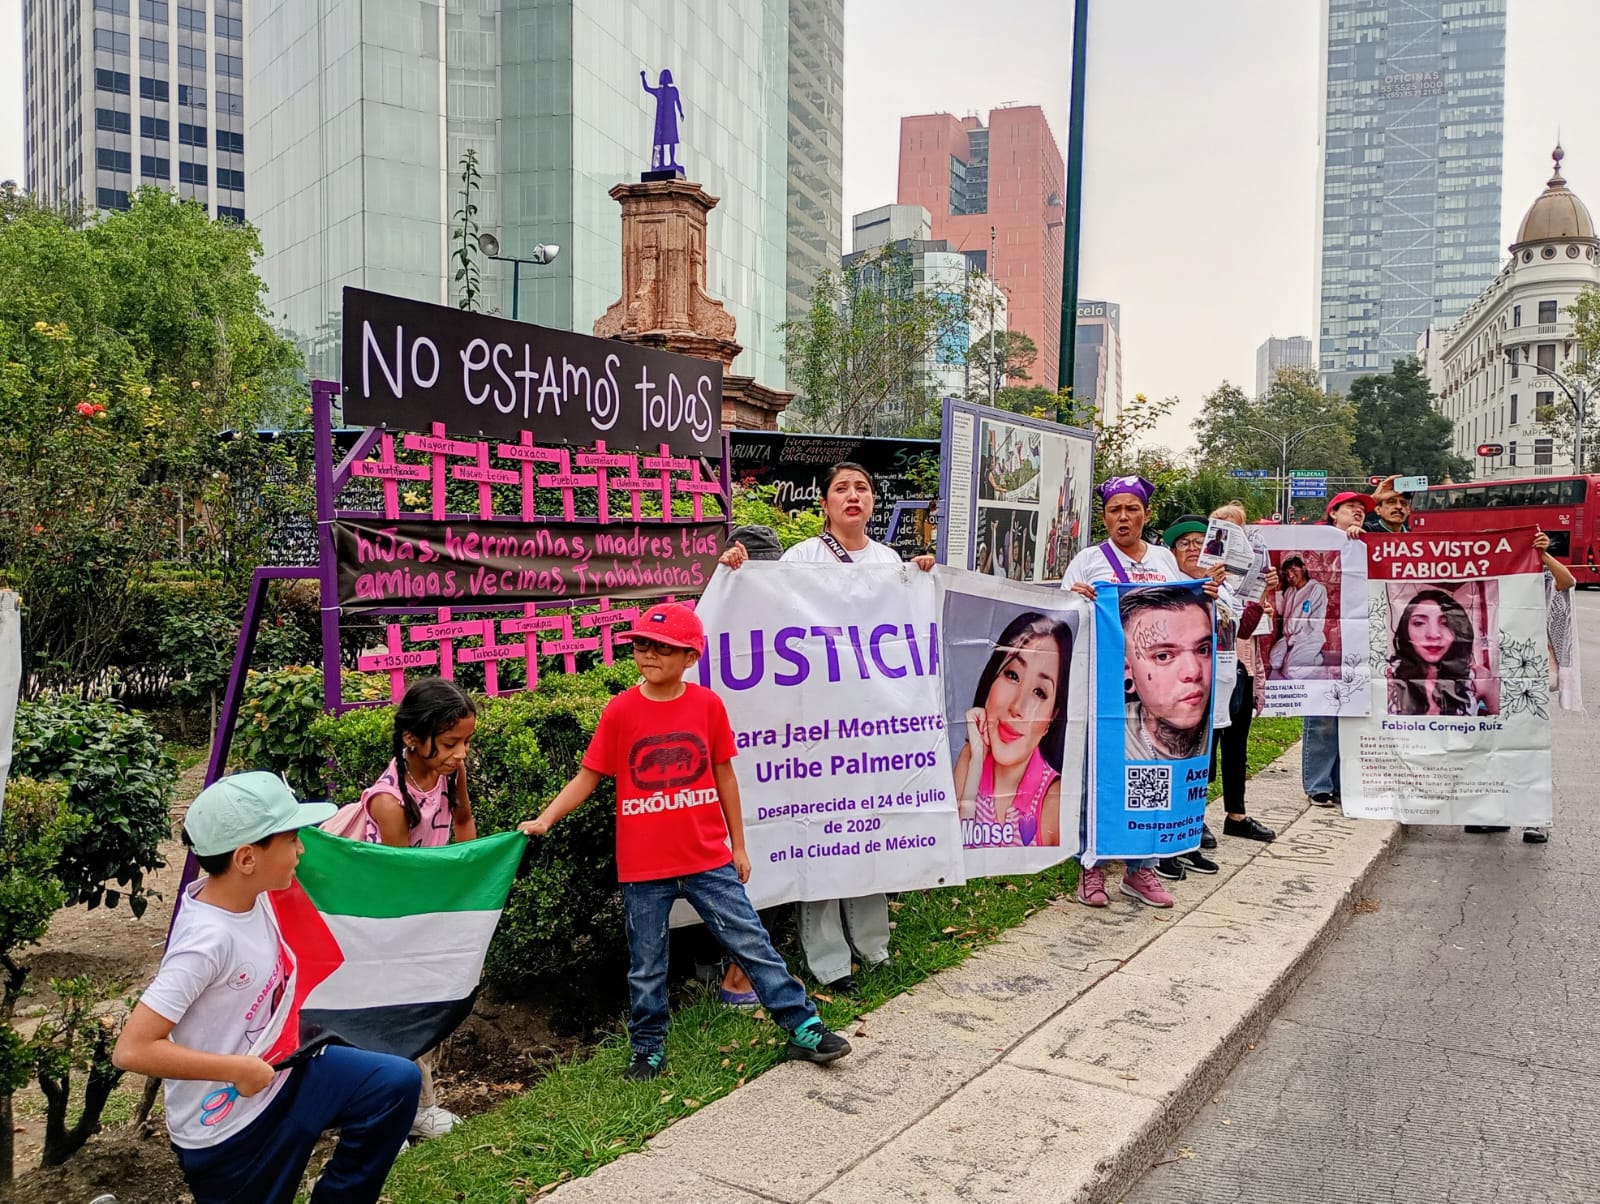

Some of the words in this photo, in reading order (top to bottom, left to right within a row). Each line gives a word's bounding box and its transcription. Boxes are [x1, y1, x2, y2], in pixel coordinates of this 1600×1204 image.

[1384, 71, 1439, 84] OFICINAS
[1077, 304, 1103, 316] celó
[362, 320, 440, 398] No
[419, 437, 455, 452] Nayarit
[510, 446, 548, 459] Oaxaca
[362, 463, 374, 475] No
[551, 475, 579, 486] Puebla
[1371, 541, 1424, 562] ¿HAS
[1429, 539, 1491, 557] VISTO
[1494, 537, 1513, 553] A
[1391, 559, 1490, 578] FABIOLA?
[426, 625, 464, 638] Sonora
[470, 647, 510, 660] Tabasco
[552, 641, 585, 651] Tlaxcala
[383, 653, 422, 667] 135,000
[782, 719, 830, 749] Jael
[1382, 720, 1426, 732] Fabiola
[1429, 721, 1476, 735] Cornejo
[1479, 719, 1503, 731] Ruíz
[756, 760, 822, 783] Uribe
[831, 749, 937, 776] Palmeros
[758, 796, 857, 820] Desaparecida
[860, 795, 875, 809] el
[878, 794, 893, 808] 24
[896, 791, 913, 806] de
[915, 789, 946, 807] julio
[823, 820, 842, 834] de
[847, 817, 881, 833] 2020
[1127, 813, 1194, 833] Desapareció
[962, 817, 1014, 848] Monse
[1160, 833, 1174, 844] 27
[1177, 831, 1187, 841] de
[769, 849, 787, 863] en
[790, 844, 804, 858] la
[808, 841, 861, 858] Ciudad
[864, 838, 881, 854] de
[886, 834, 936, 852] México
